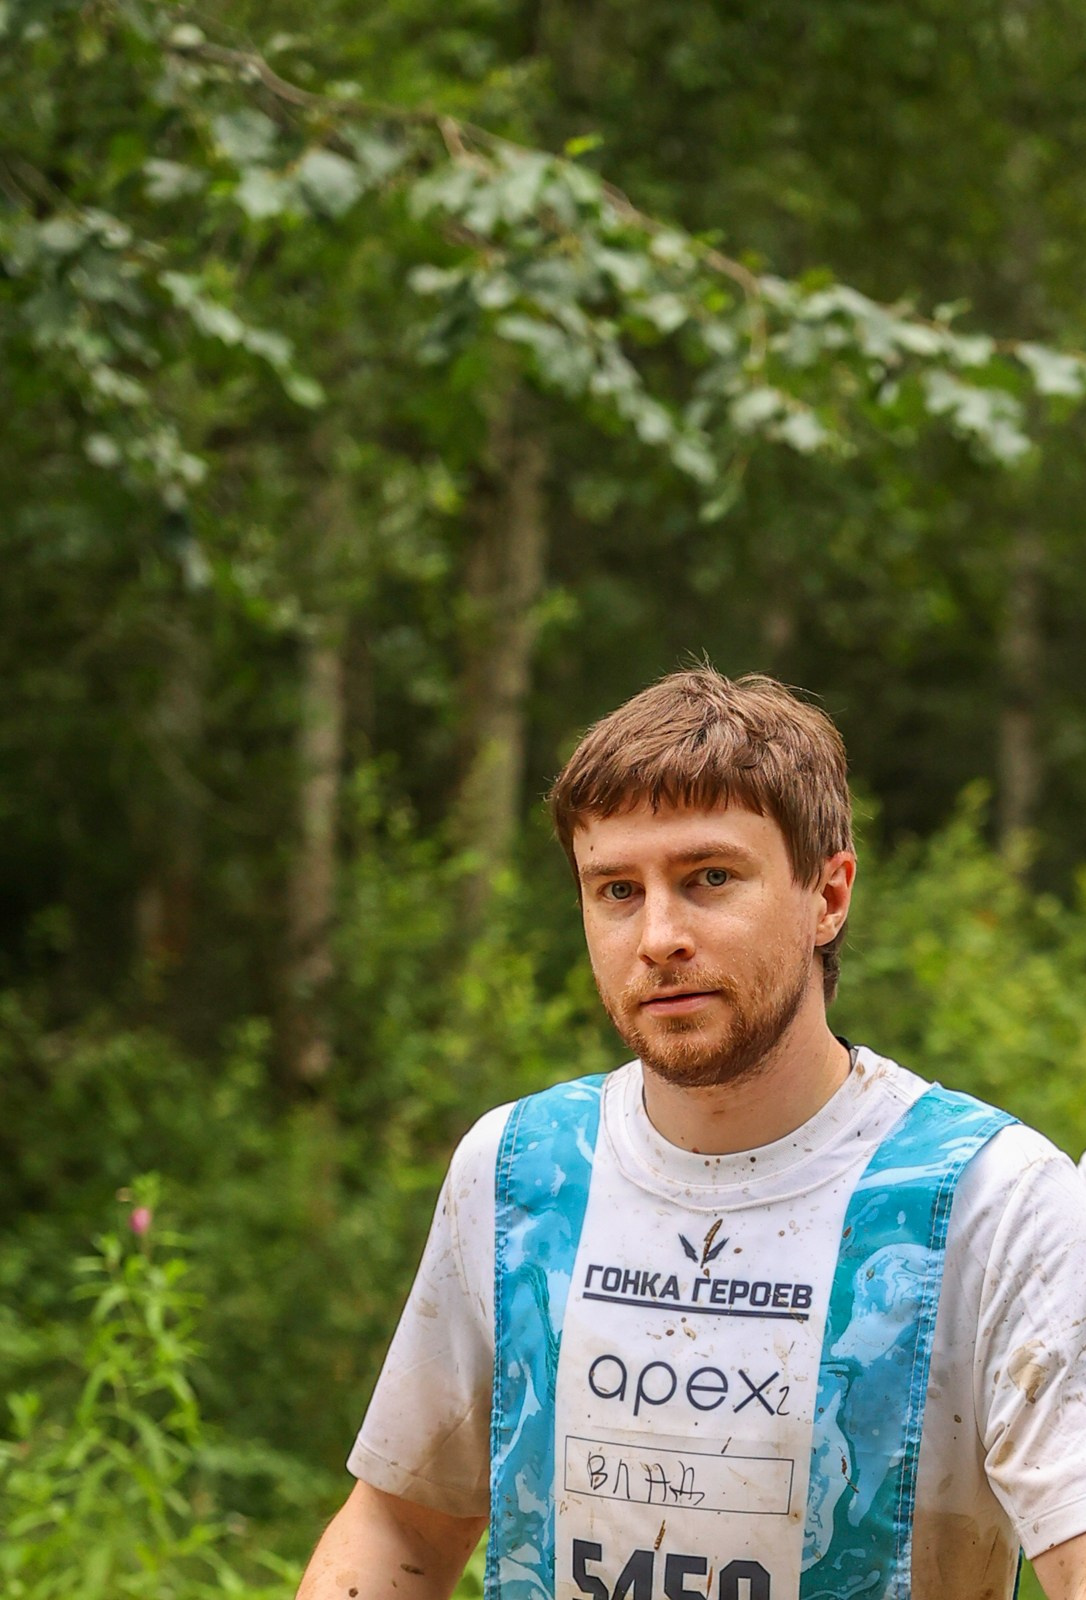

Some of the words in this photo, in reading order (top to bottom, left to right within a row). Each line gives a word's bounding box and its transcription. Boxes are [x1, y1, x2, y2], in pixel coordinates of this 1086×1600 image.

[584, 1264, 681, 1301] ГОНКА
[691, 1277, 813, 1309] ГЕРОЕВ
[588, 1354, 780, 1416] apex
